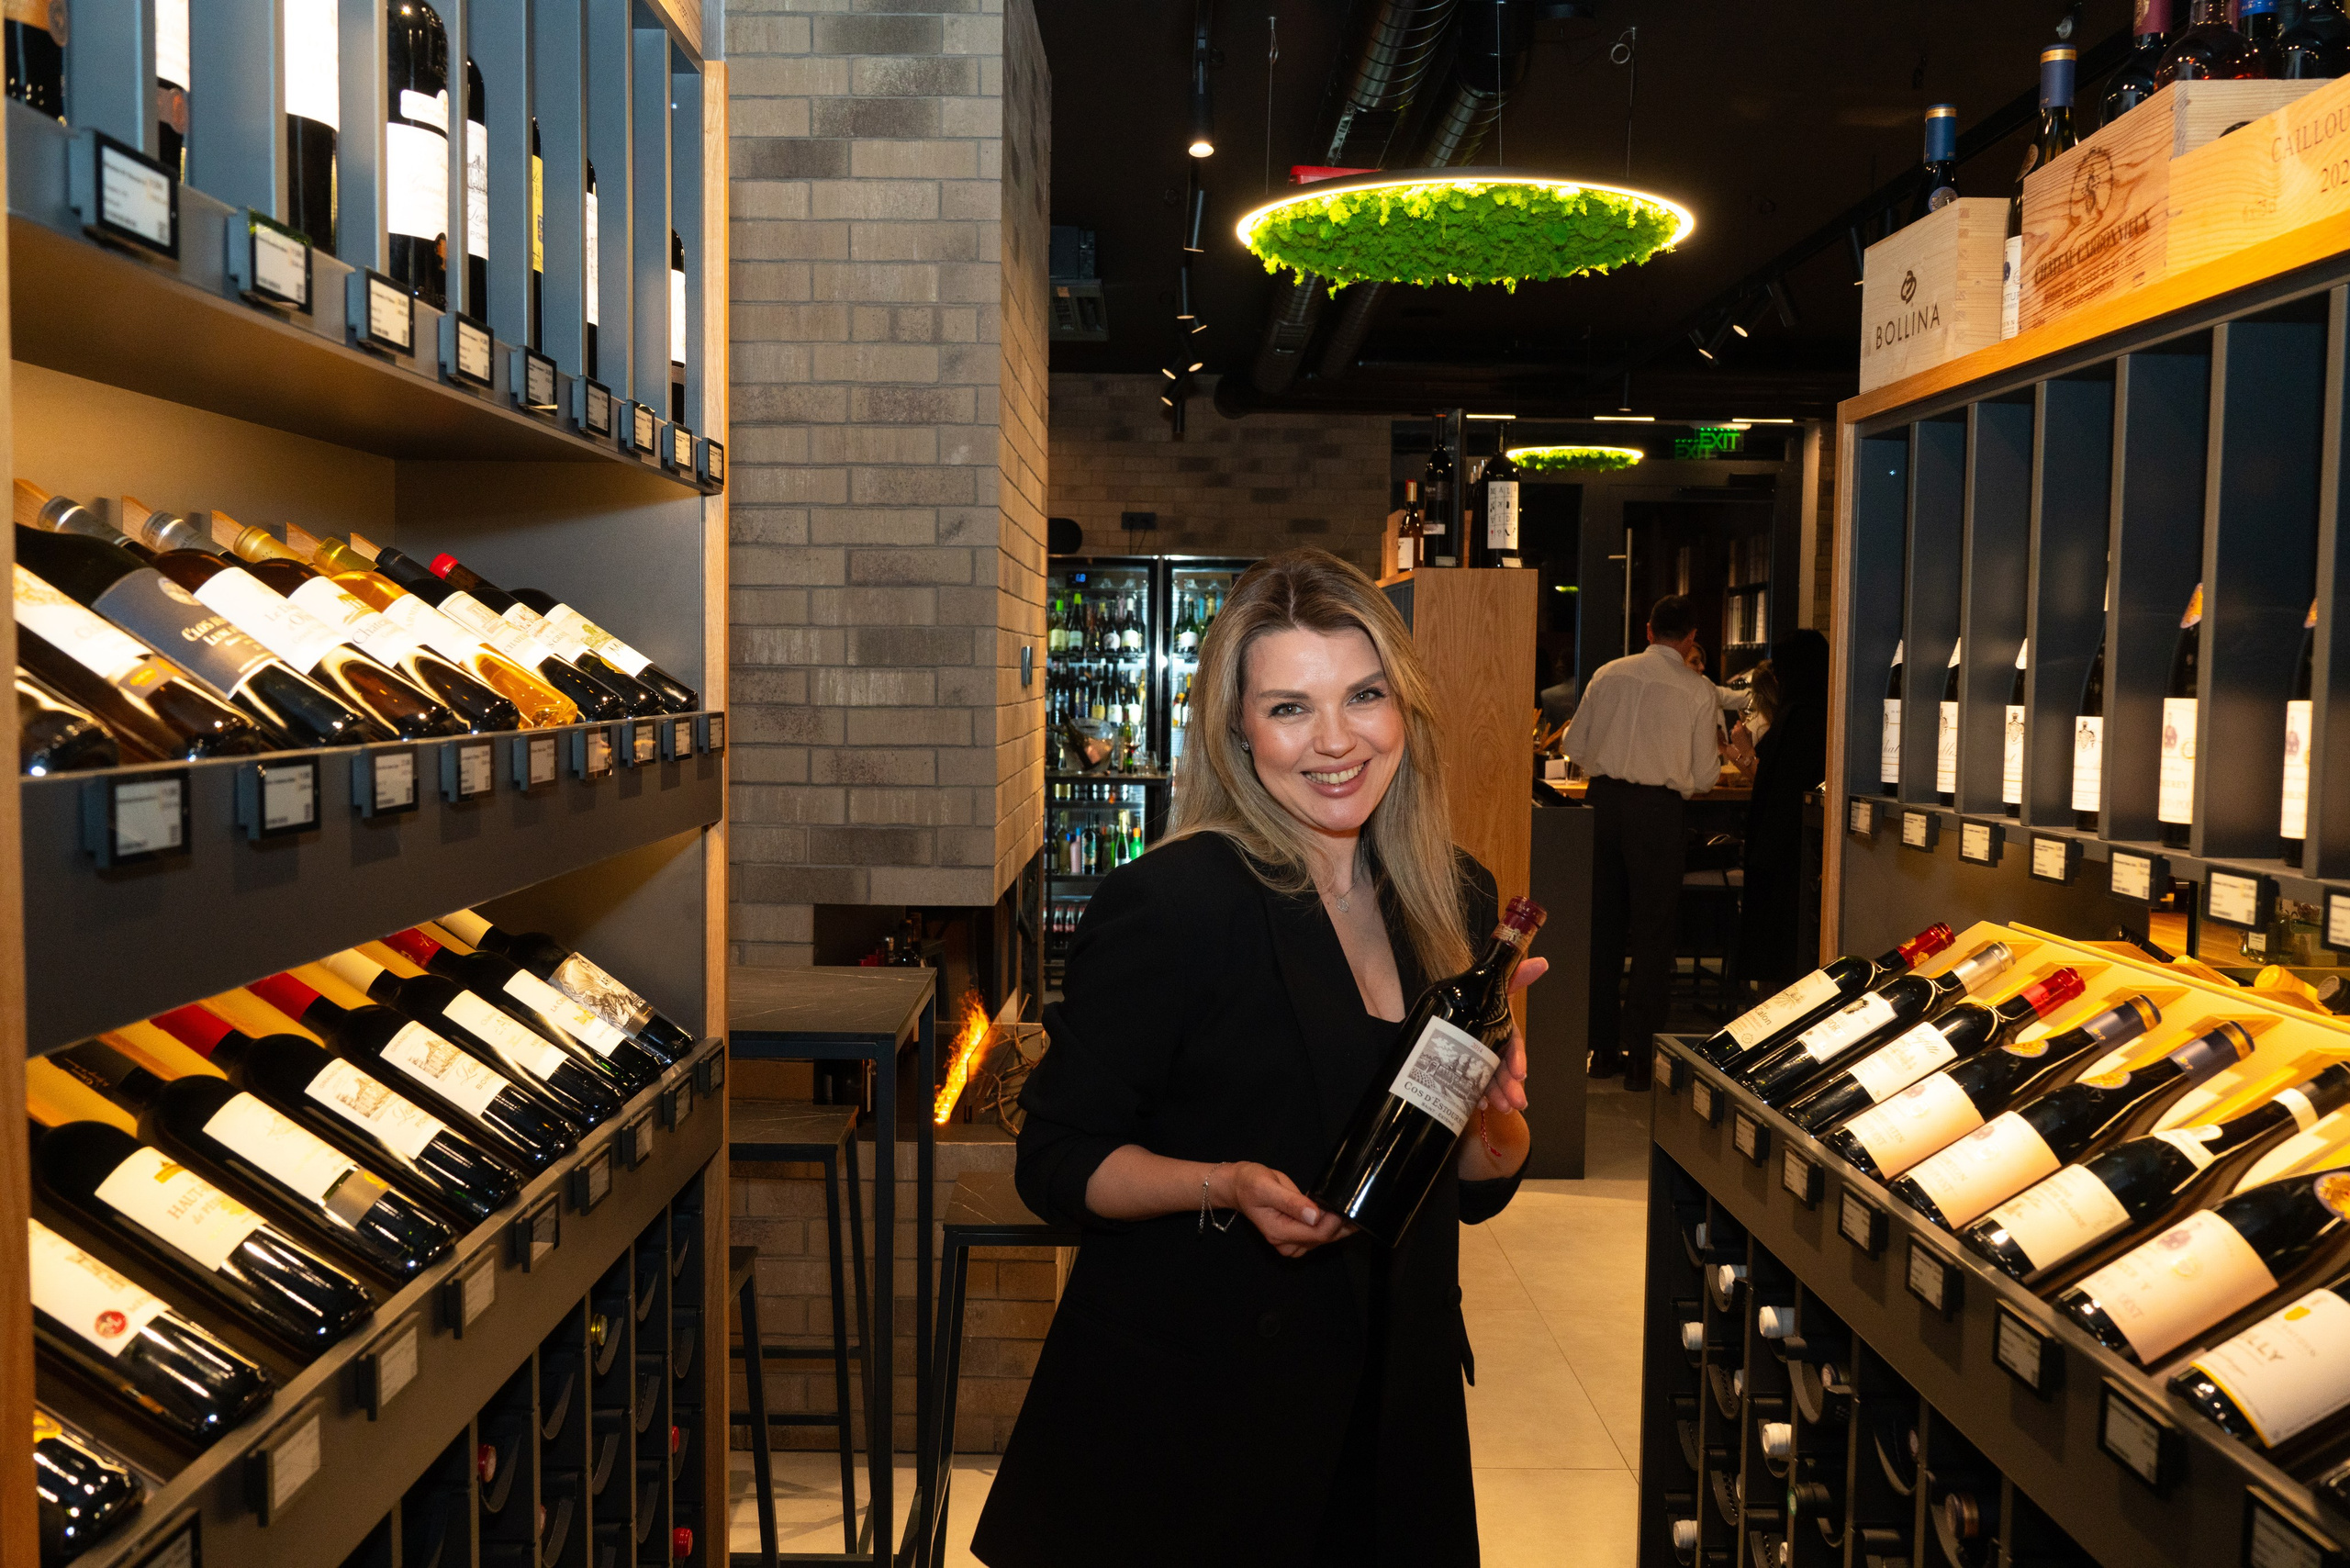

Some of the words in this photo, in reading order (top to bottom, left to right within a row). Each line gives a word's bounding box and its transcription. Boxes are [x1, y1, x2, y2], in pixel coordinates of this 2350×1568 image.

[1875, 302, 1941, 350] BOLLINA
[1700, 432, 1740, 449] EXIT
[180, 618, 215, 641] CLOS
[1471, 1041, 1483, 1053] 2014
[1404, 1081, 1424, 1098] COS
